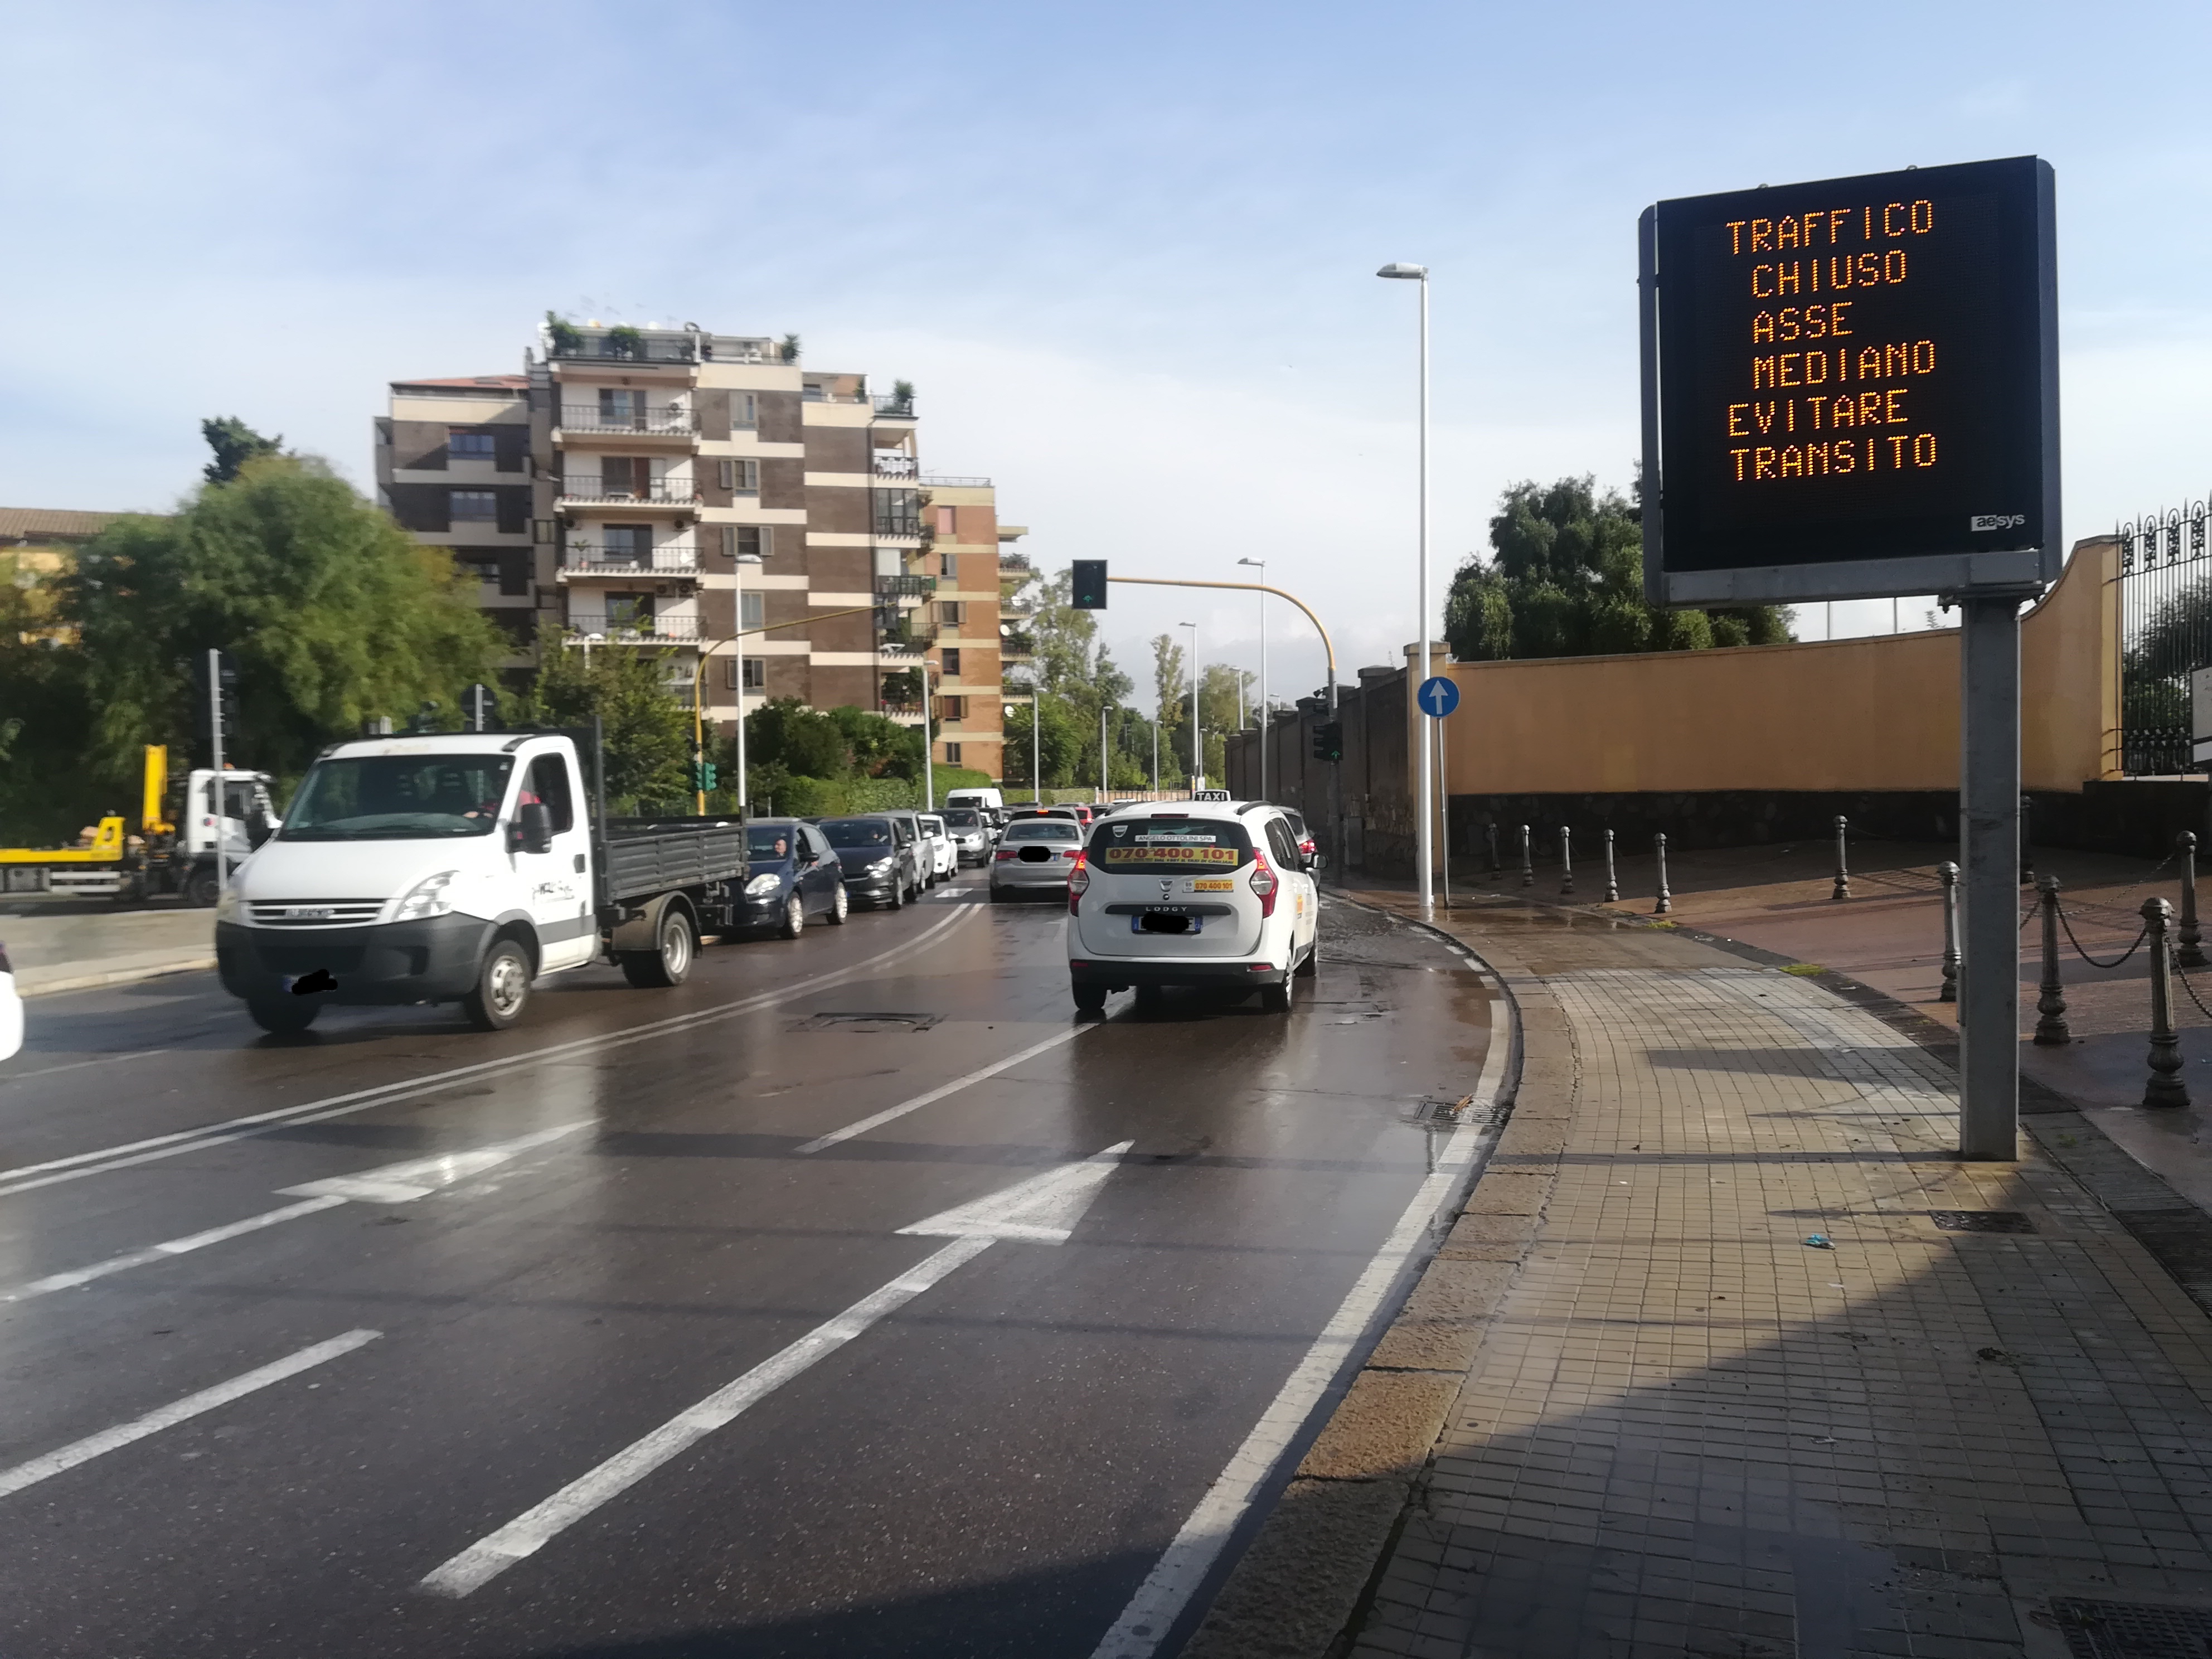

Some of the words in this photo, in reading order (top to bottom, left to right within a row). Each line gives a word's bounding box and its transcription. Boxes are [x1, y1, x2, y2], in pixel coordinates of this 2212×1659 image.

[1726, 199, 1934, 255] TRAFFICO
[1752, 249, 1908, 298] CHIUSO
[1753, 302, 1853, 343] ASSE
[1753, 340, 1936, 389] MEDIANO
[1728, 388, 1909, 437] EVITARE
[1729, 433, 1938, 482] TRANSITO
[1975, 514, 2025, 528] aesys
[1197, 792, 1225, 801] TAXI
[1109, 848, 1148, 858] 070
[1153, 848, 1194, 858] 400
[1200, 848, 1235, 860] 101
